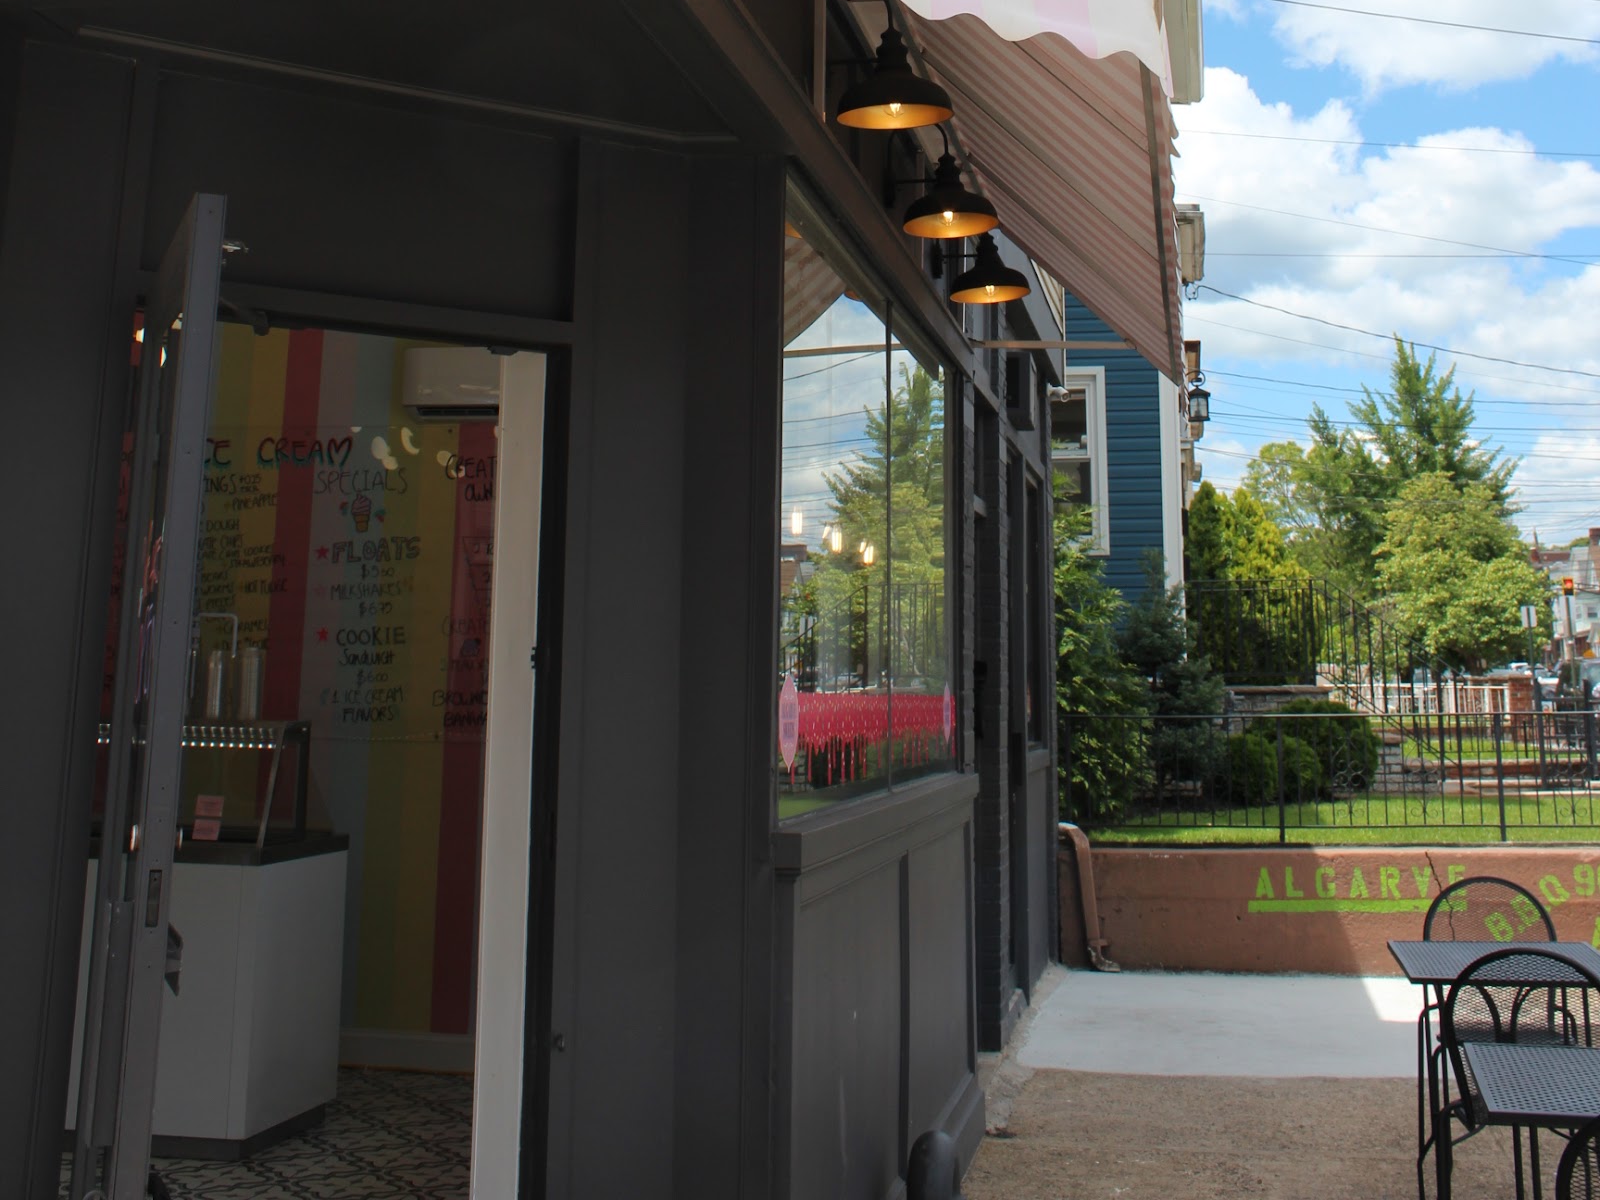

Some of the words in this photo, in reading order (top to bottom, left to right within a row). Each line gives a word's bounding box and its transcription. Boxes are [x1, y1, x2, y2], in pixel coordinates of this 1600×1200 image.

[257, 435, 353, 467] CREAM
[314, 467, 409, 495] SPECIALS
[332, 536, 421, 563] FLOATS
[336, 625, 407, 646] COOKIE
[365, 685, 404, 704] CREAM
[342, 705, 394, 723] FLAVORS
[1255, 864, 1467, 898] ALGARVE
